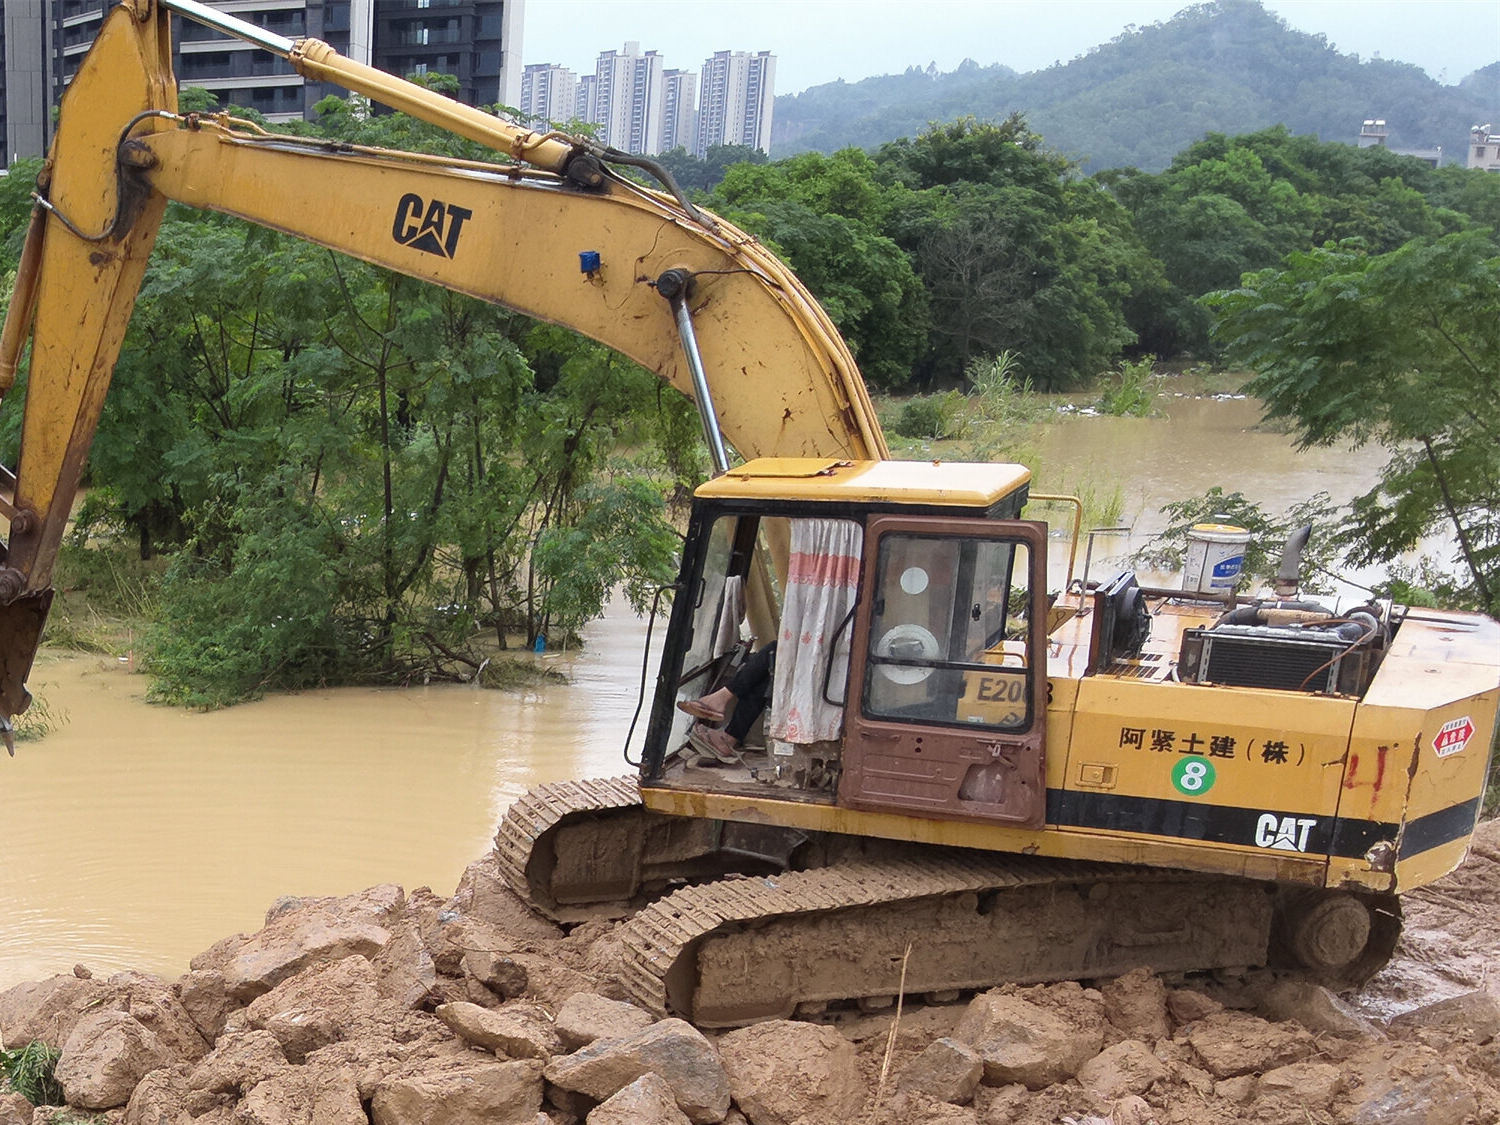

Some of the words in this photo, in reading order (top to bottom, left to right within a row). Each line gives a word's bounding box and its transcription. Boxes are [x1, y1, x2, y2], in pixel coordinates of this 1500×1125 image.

[392, 193, 473, 260] CAT
[977, 677, 1054, 705] E20
[1180, 761, 1207, 790] 8
[1255, 813, 1317, 852] CAT
